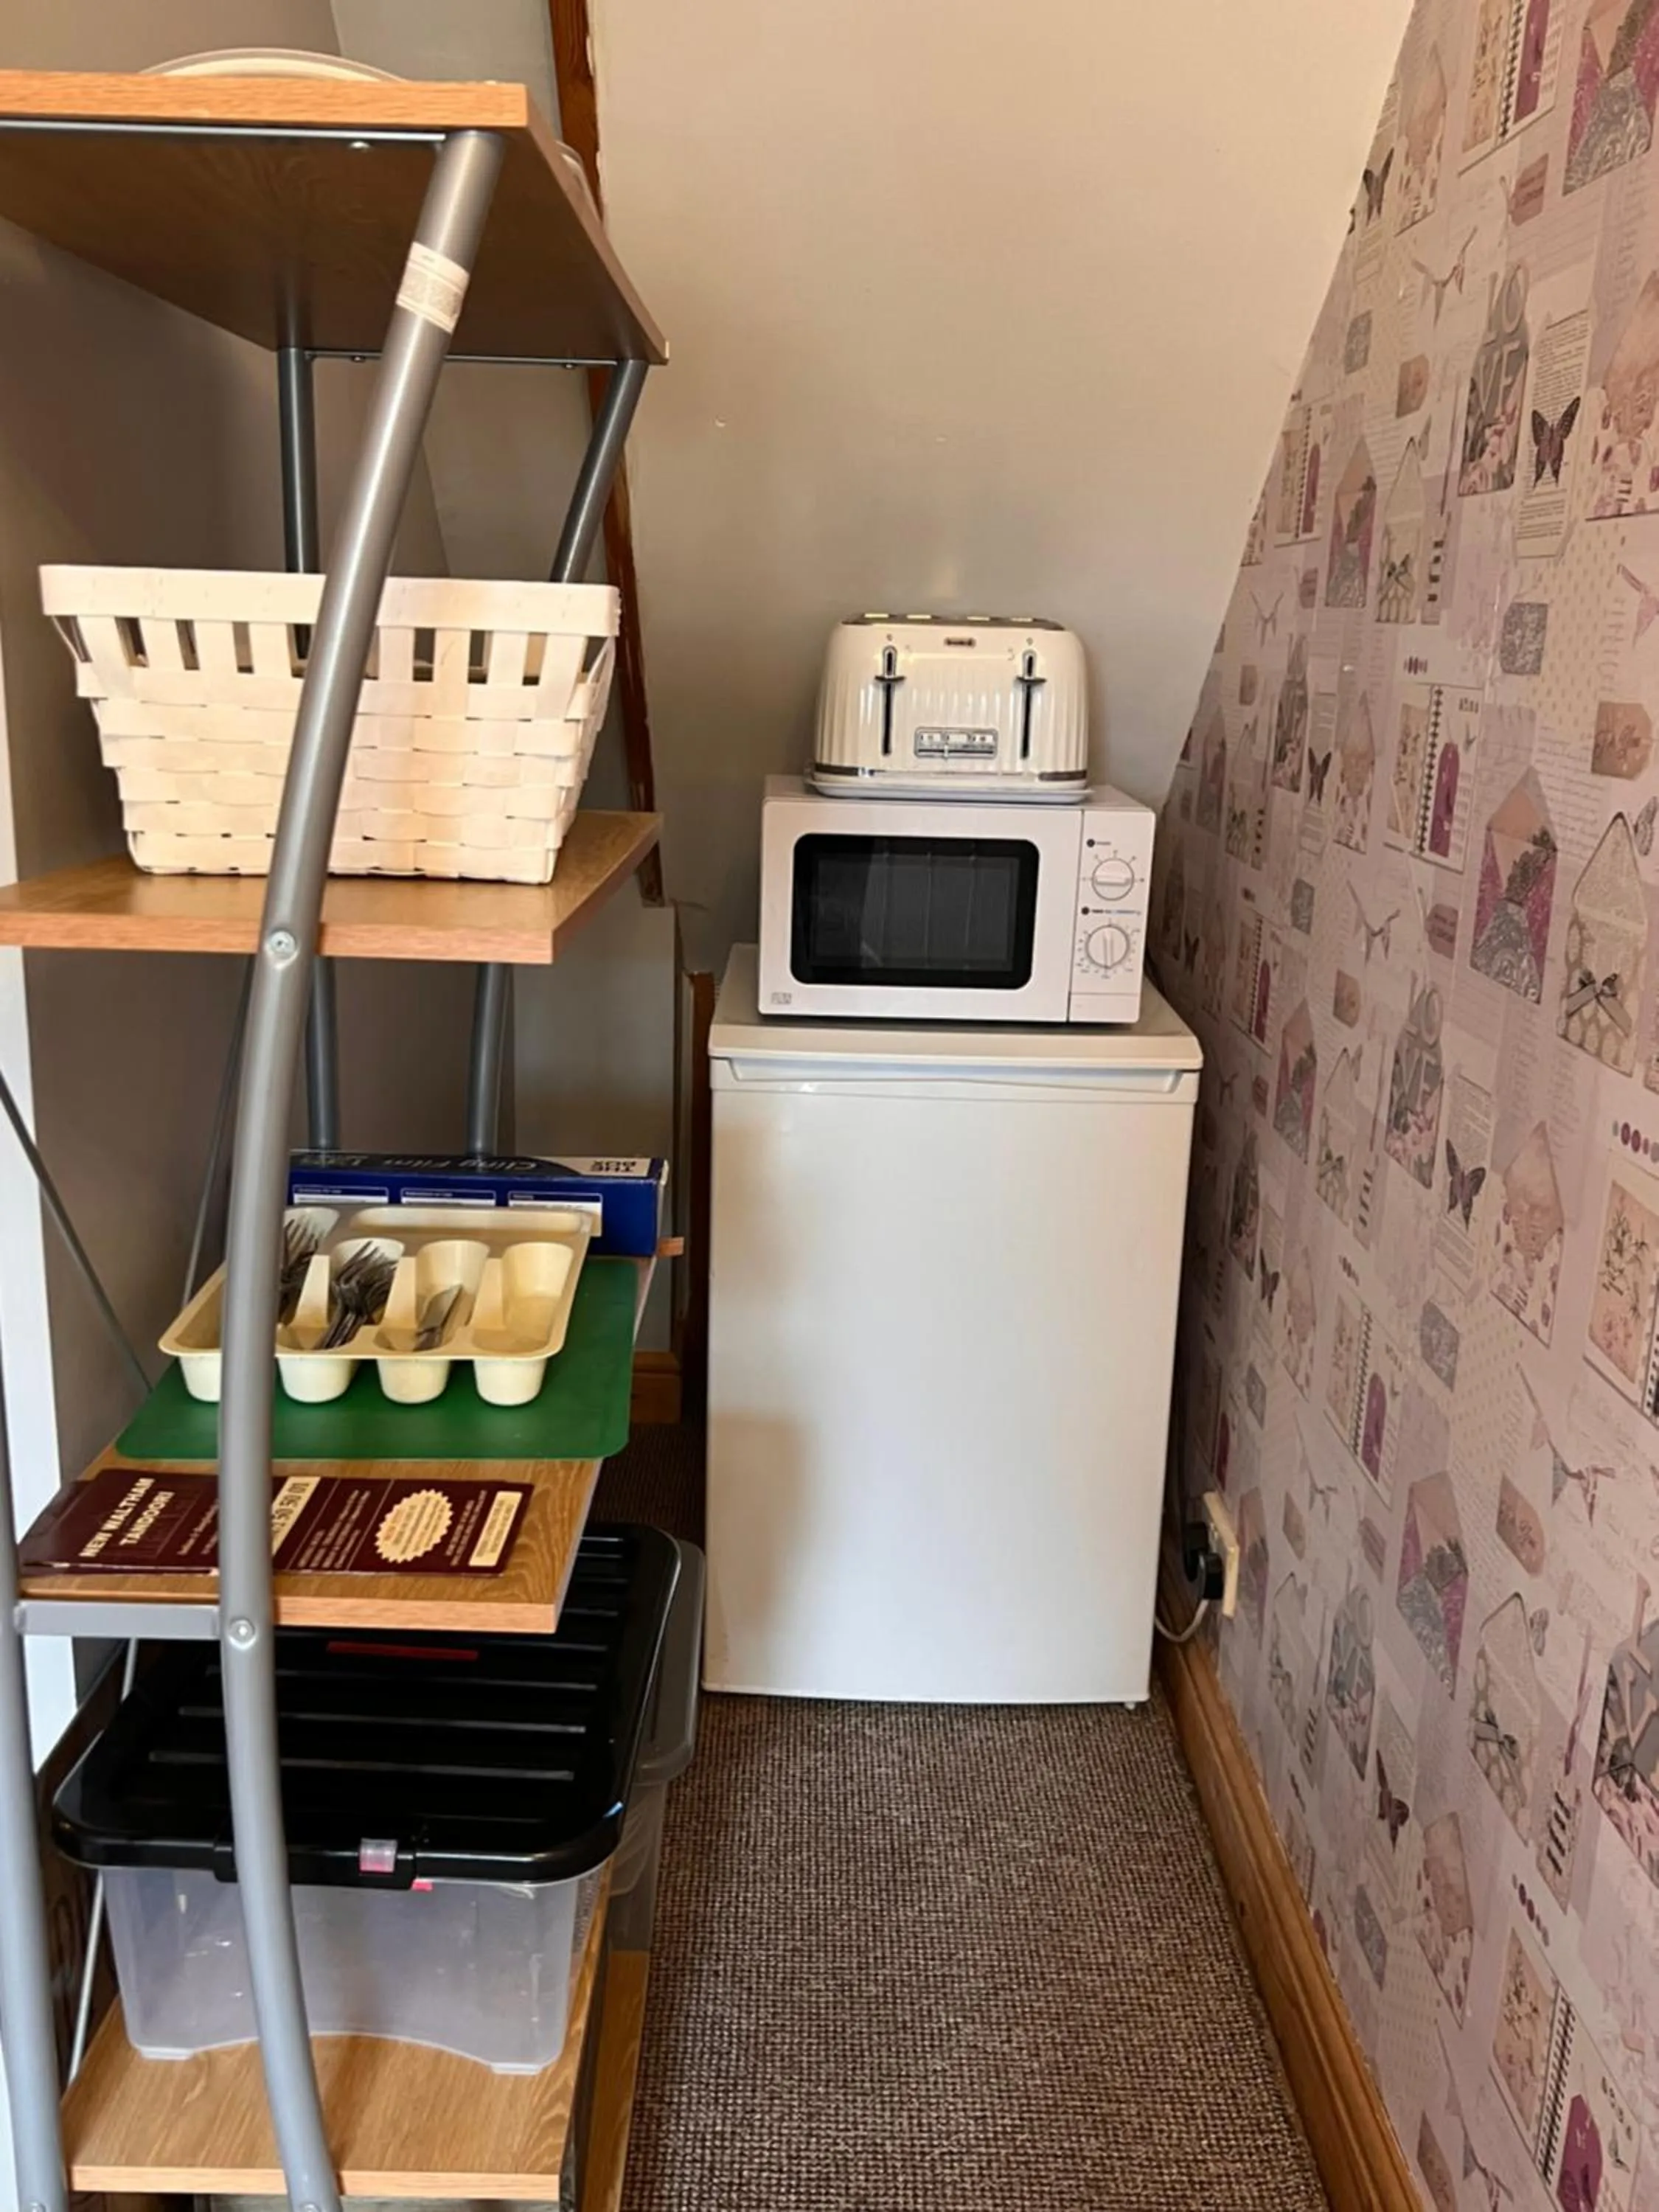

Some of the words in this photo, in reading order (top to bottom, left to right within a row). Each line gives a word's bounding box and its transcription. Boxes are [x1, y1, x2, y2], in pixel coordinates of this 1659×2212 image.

[78, 1532, 112, 1557] NEW
[100, 1478, 155, 1531] WALTHAM
[119, 1492, 175, 1545] TANDOORI
